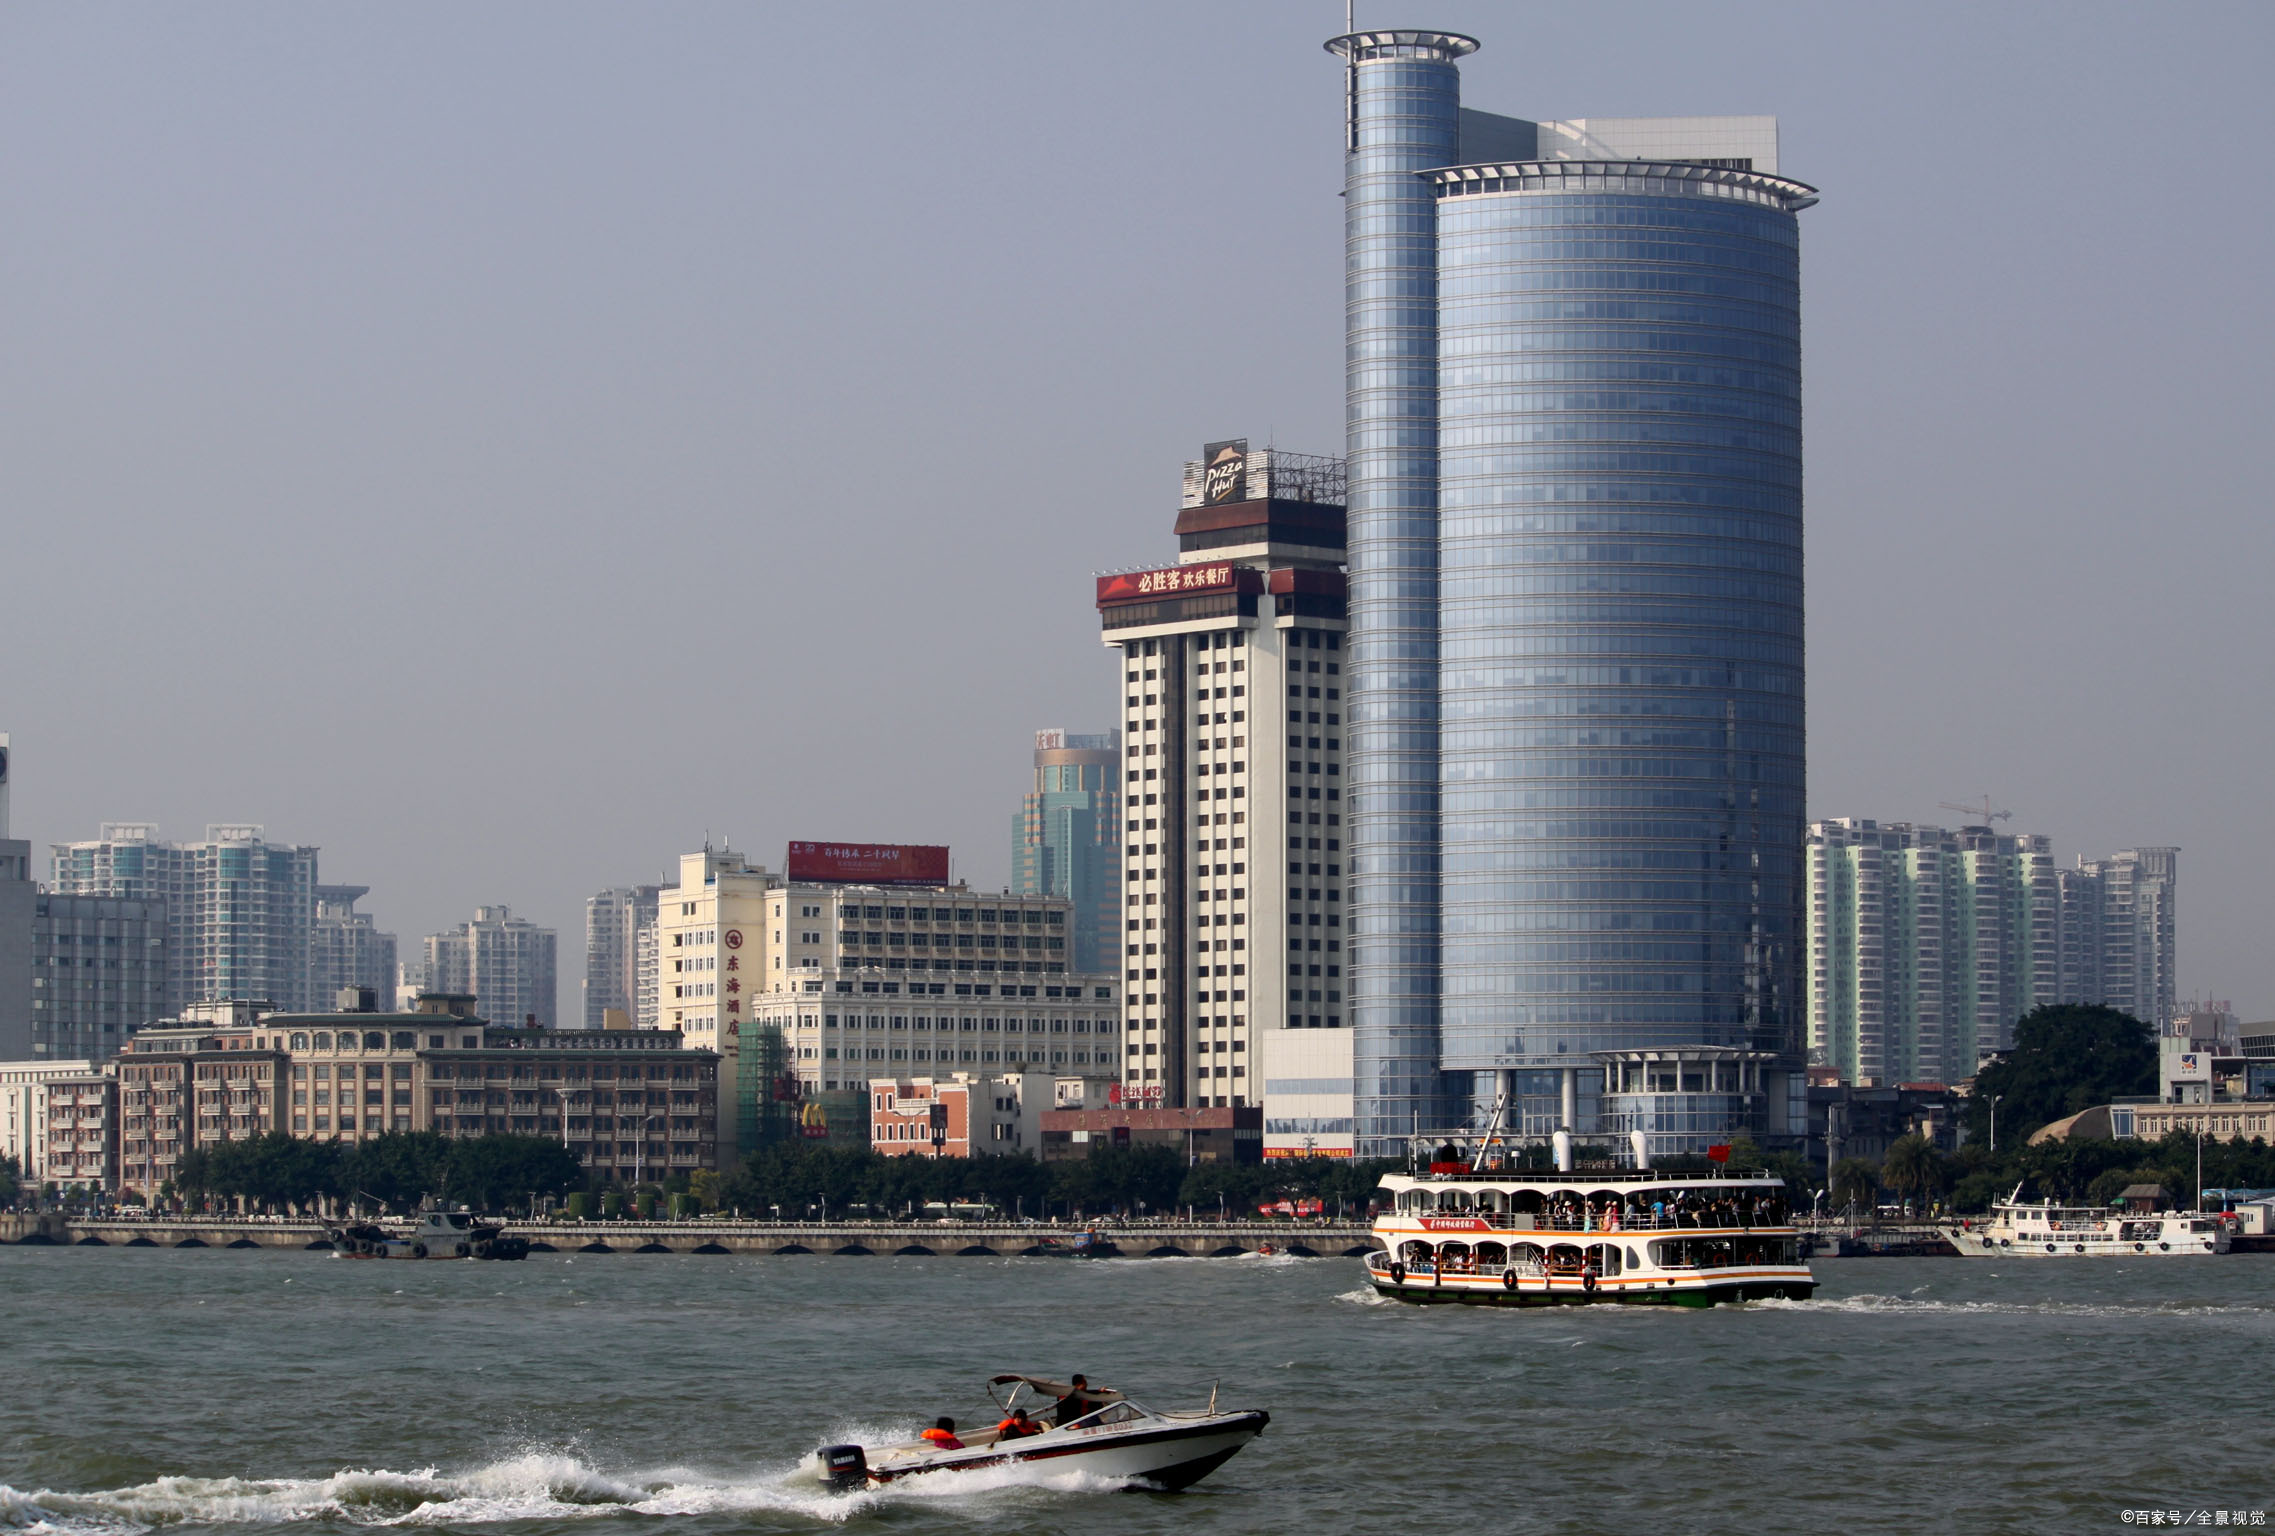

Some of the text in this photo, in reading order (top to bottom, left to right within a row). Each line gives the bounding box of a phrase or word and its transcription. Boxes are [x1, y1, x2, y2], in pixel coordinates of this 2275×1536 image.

[1205, 462, 1243, 493] Pizza
[1212, 473, 1239, 498] Hut
[1138, 567, 1229, 593] 必胜客 欢乐餐厅
[726, 955, 741, 1035] 东海酒店
[832, 1454, 856, 1465] YAMAHA
